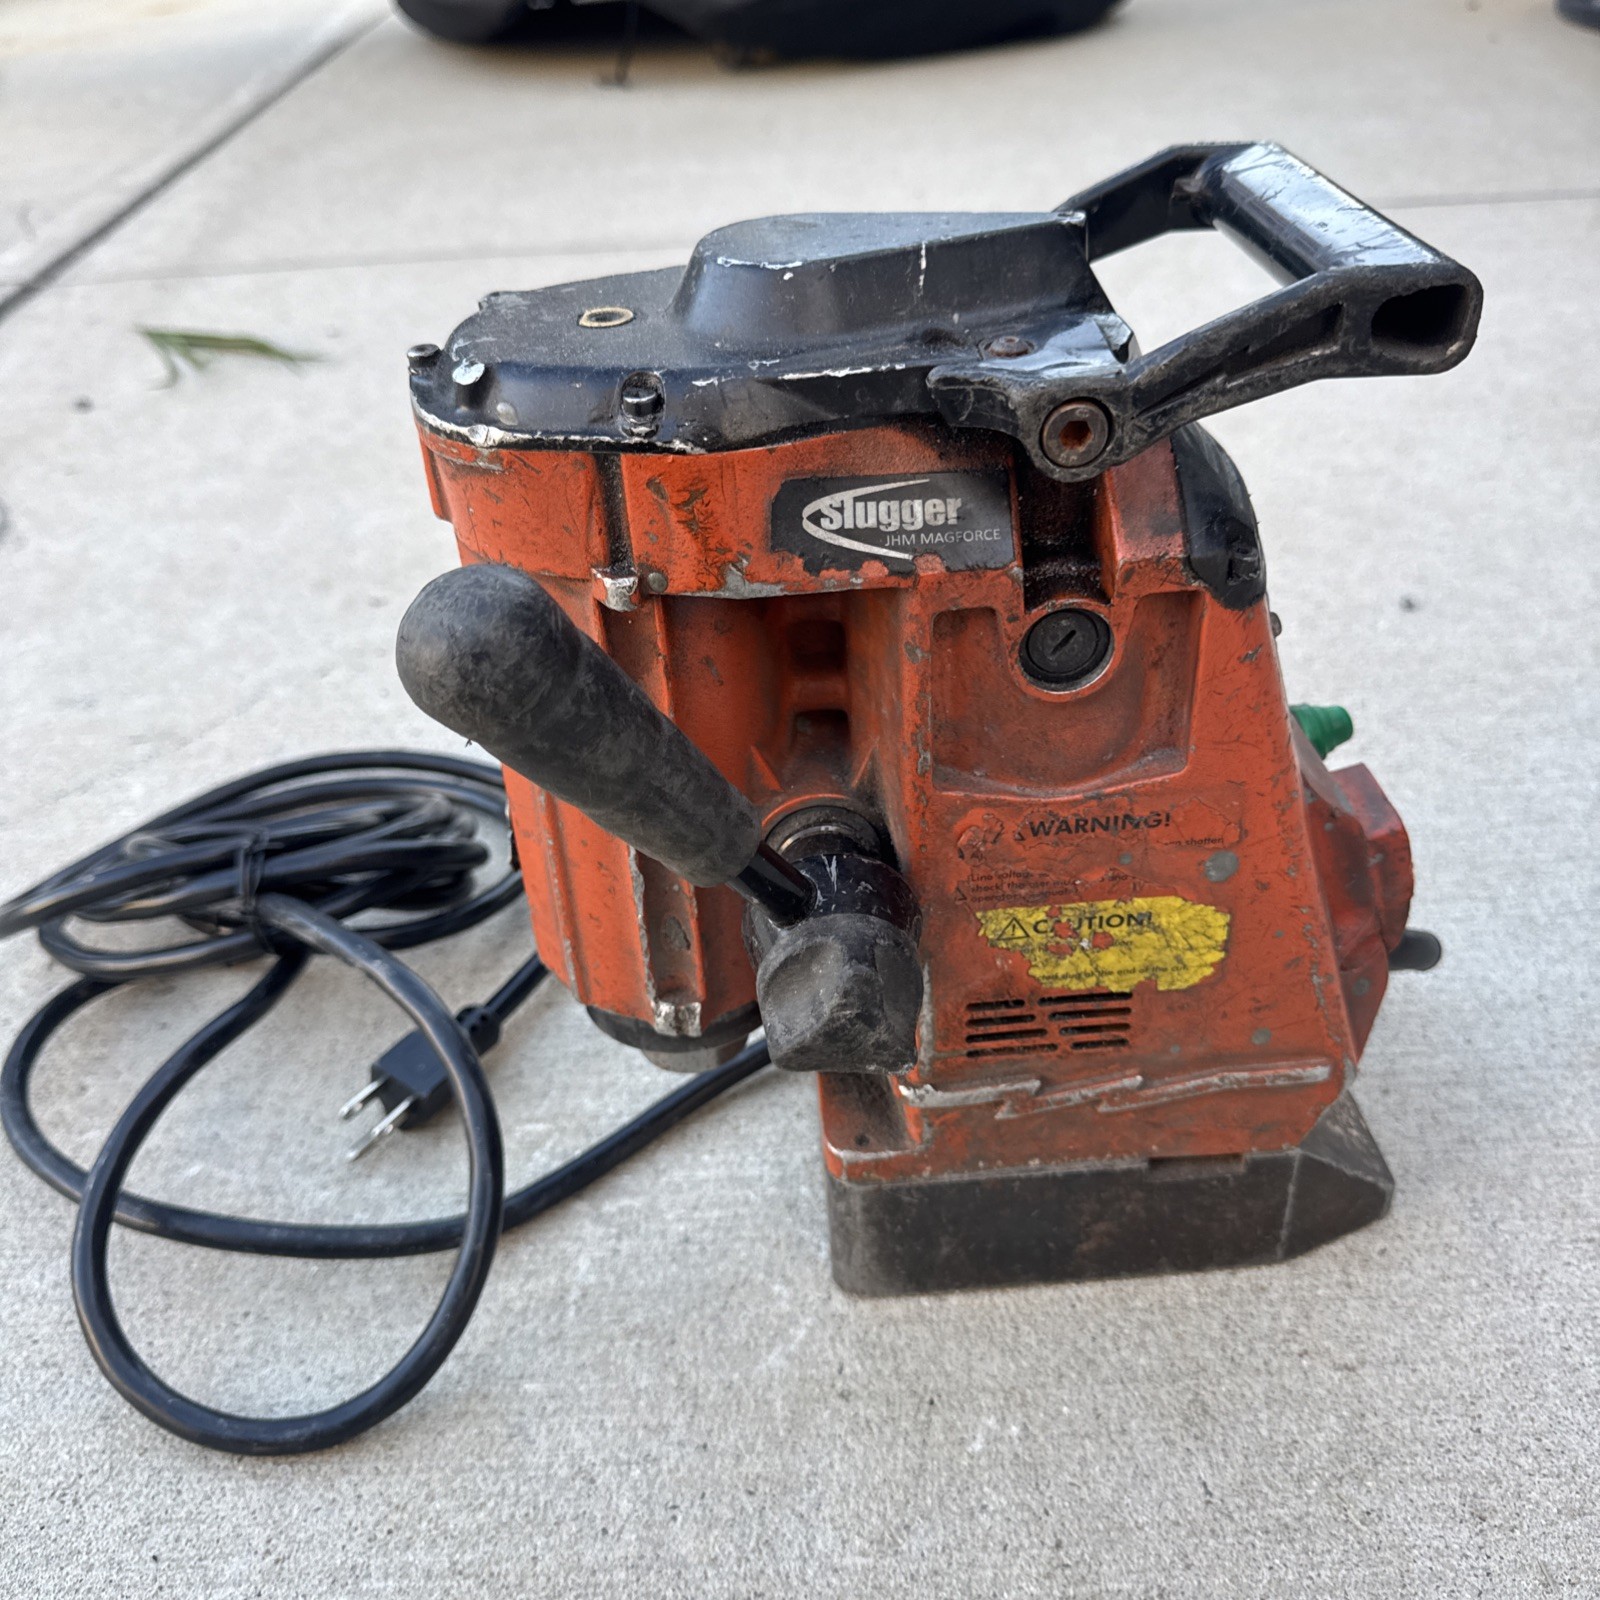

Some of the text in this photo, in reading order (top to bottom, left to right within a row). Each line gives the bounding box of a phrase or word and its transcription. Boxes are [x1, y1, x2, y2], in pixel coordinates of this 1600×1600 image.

[820, 497, 962, 532] Slugger
[885, 528, 1001, 547] JHM MAGFORCE
[1029, 811, 1171, 837] WARNING!
